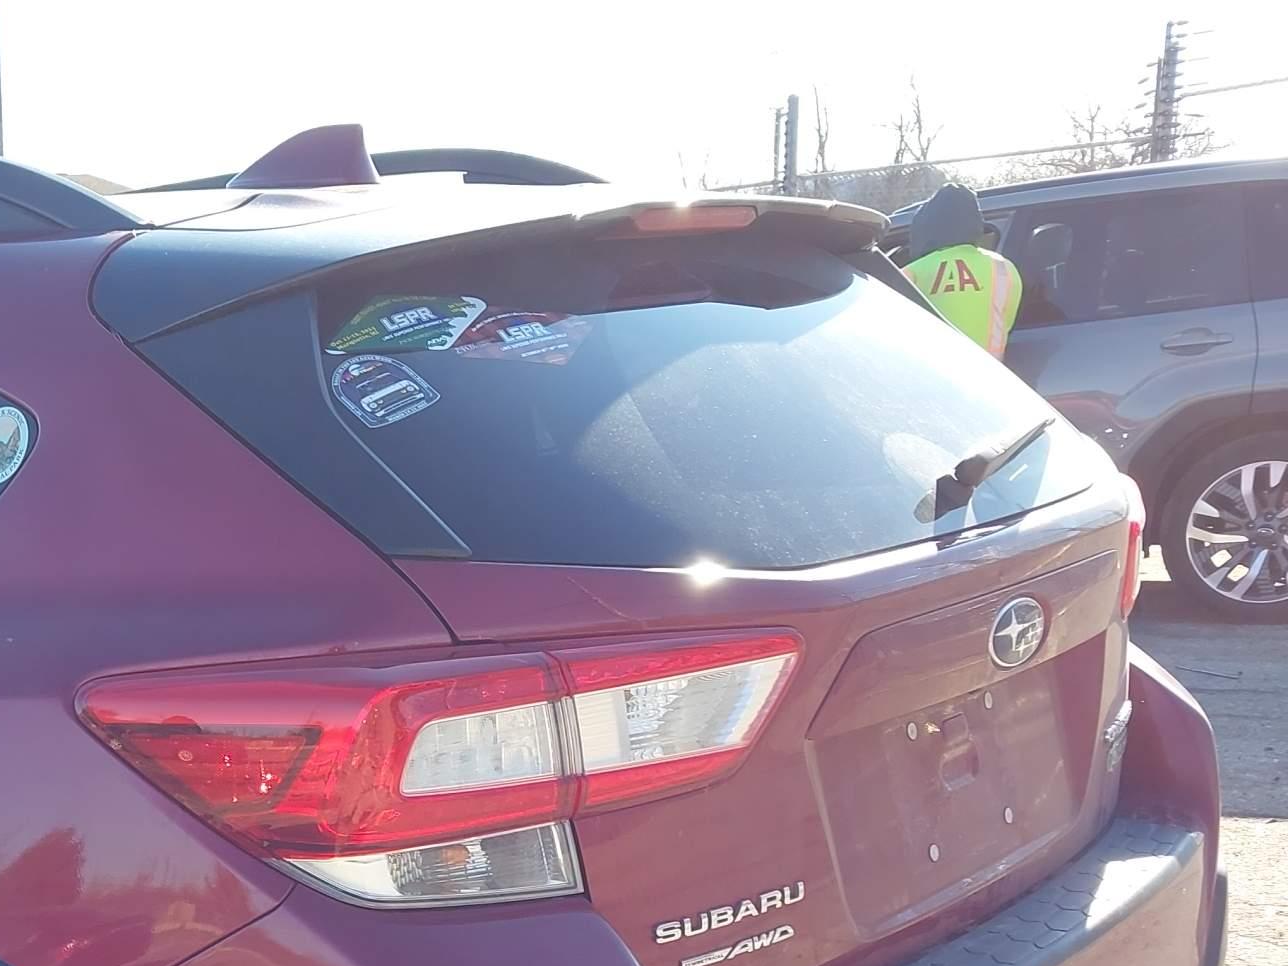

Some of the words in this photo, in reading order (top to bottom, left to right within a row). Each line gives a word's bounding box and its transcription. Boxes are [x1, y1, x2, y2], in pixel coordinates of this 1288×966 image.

[380, 306, 437, 333] LSPR
[496, 322, 552, 343] LSPR
[655, 880, 806, 944] SUBARU
[726, 924, 795, 960] AWD
